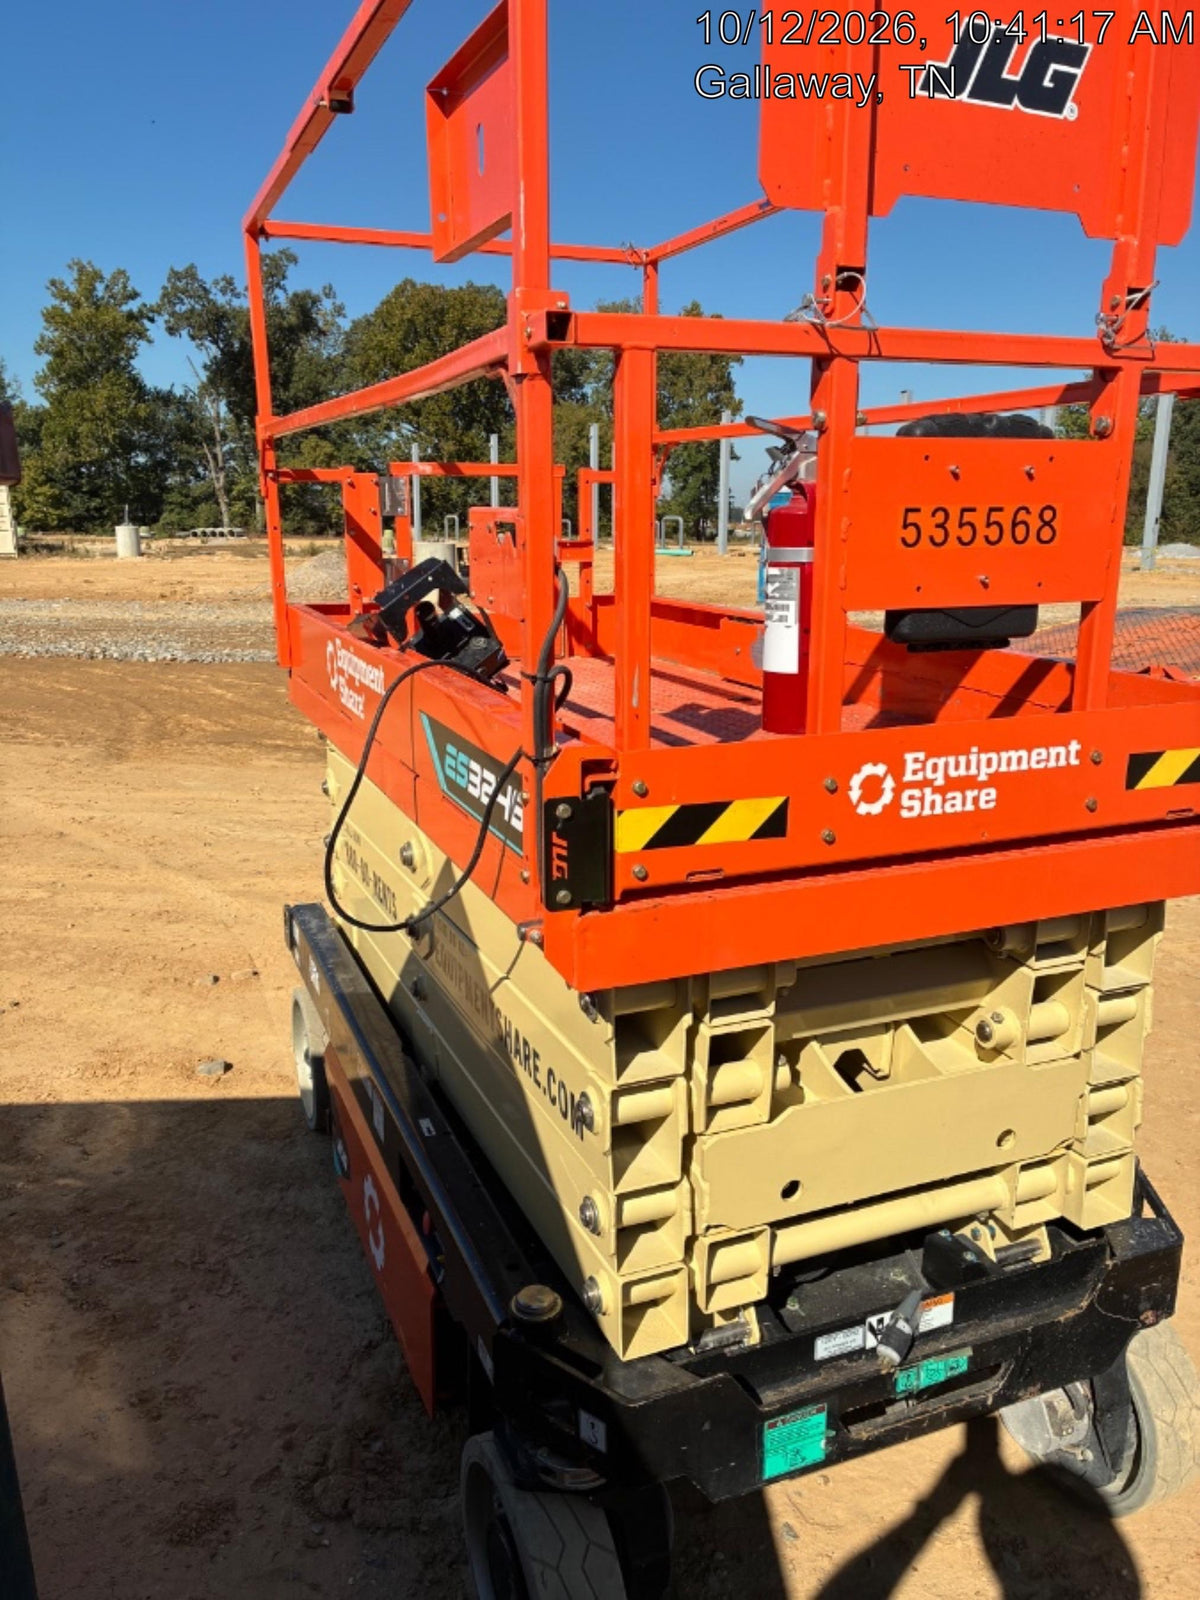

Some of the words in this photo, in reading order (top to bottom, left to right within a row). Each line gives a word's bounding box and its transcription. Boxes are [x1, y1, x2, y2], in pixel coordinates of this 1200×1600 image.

[916, 17, 1093, 119] JLG
[901, 505, 1058, 548] 535568
[903, 739, 1081, 786] Equipment
[900, 787, 997, 818] Share
[552, 831, 568, 880] JLG
